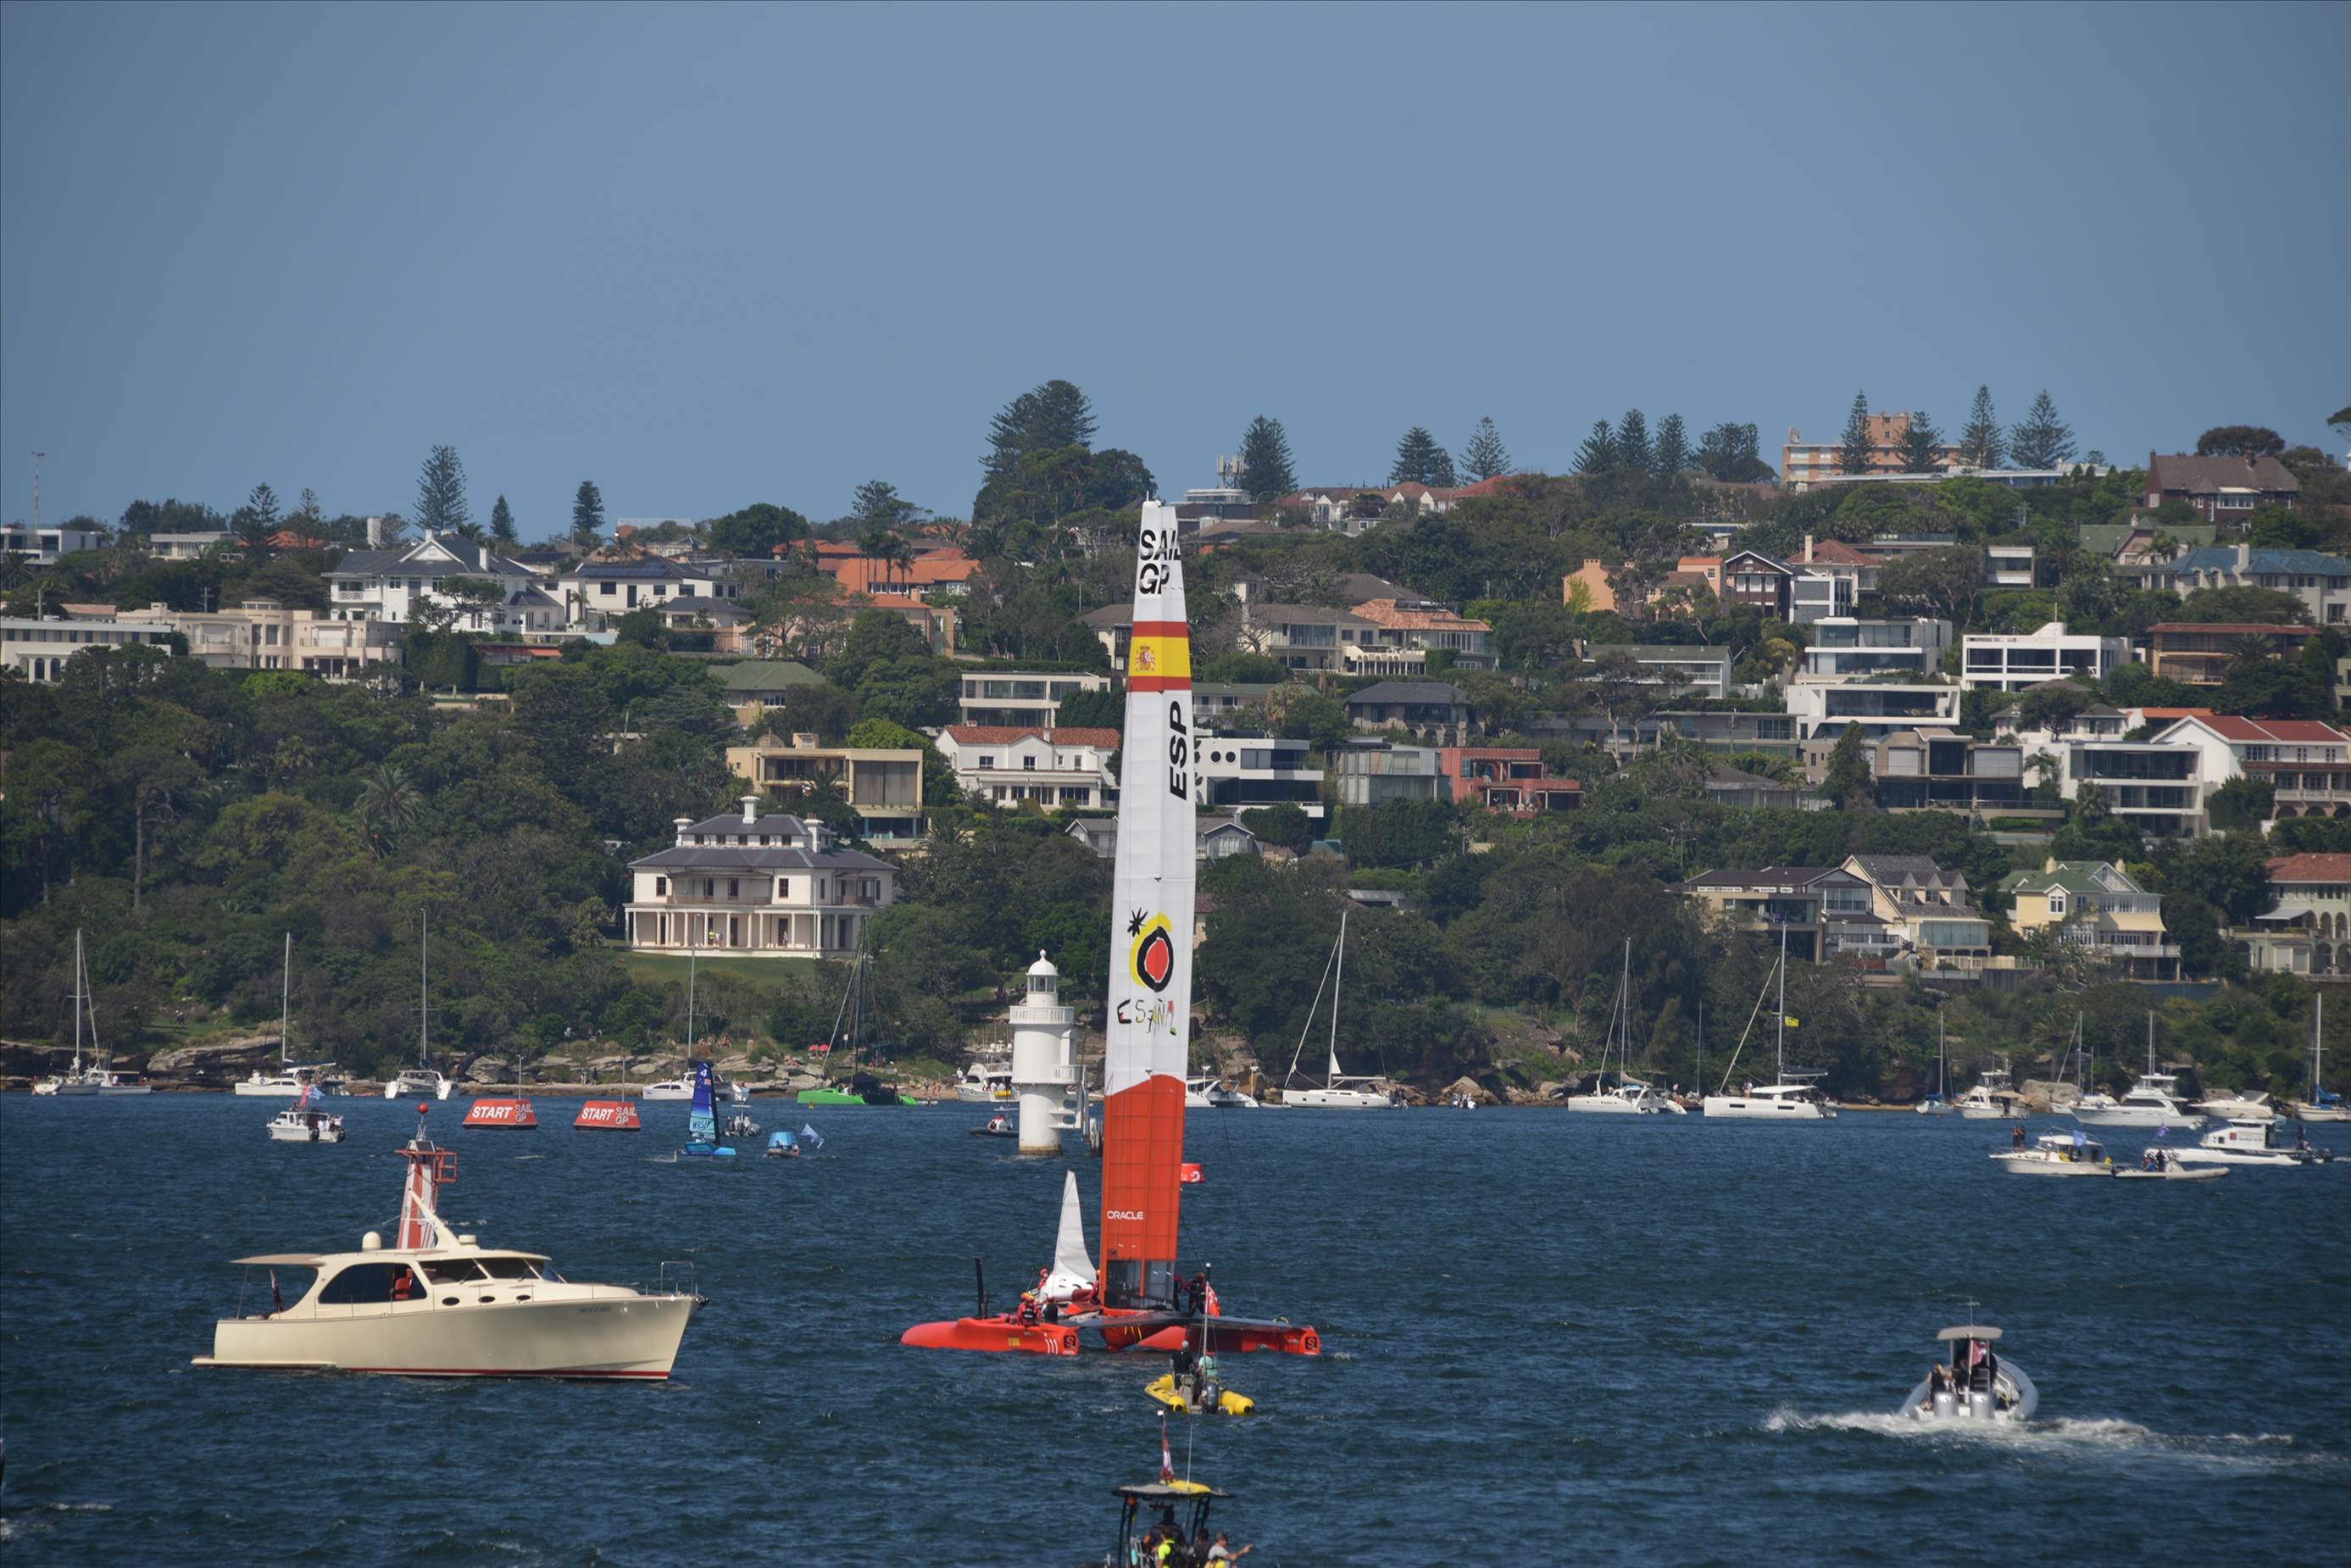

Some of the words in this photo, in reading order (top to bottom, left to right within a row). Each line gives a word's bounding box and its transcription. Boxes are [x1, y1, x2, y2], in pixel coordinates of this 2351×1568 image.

[1139, 529, 1181, 560] SAIL
[1139, 563, 1170, 594] GP
[1170, 700, 1187, 800] ESP
[471, 1105, 514, 1119] START
[514, 1104, 533, 1112] SAIL
[615, 1106, 637, 1116] SAIL
[514, 1113, 527, 1122] GP
[581, 1108, 614, 1120] START
[615, 1115, 629, 1126] GP
[1107, 1210, 1145, 1220] ORACLE
